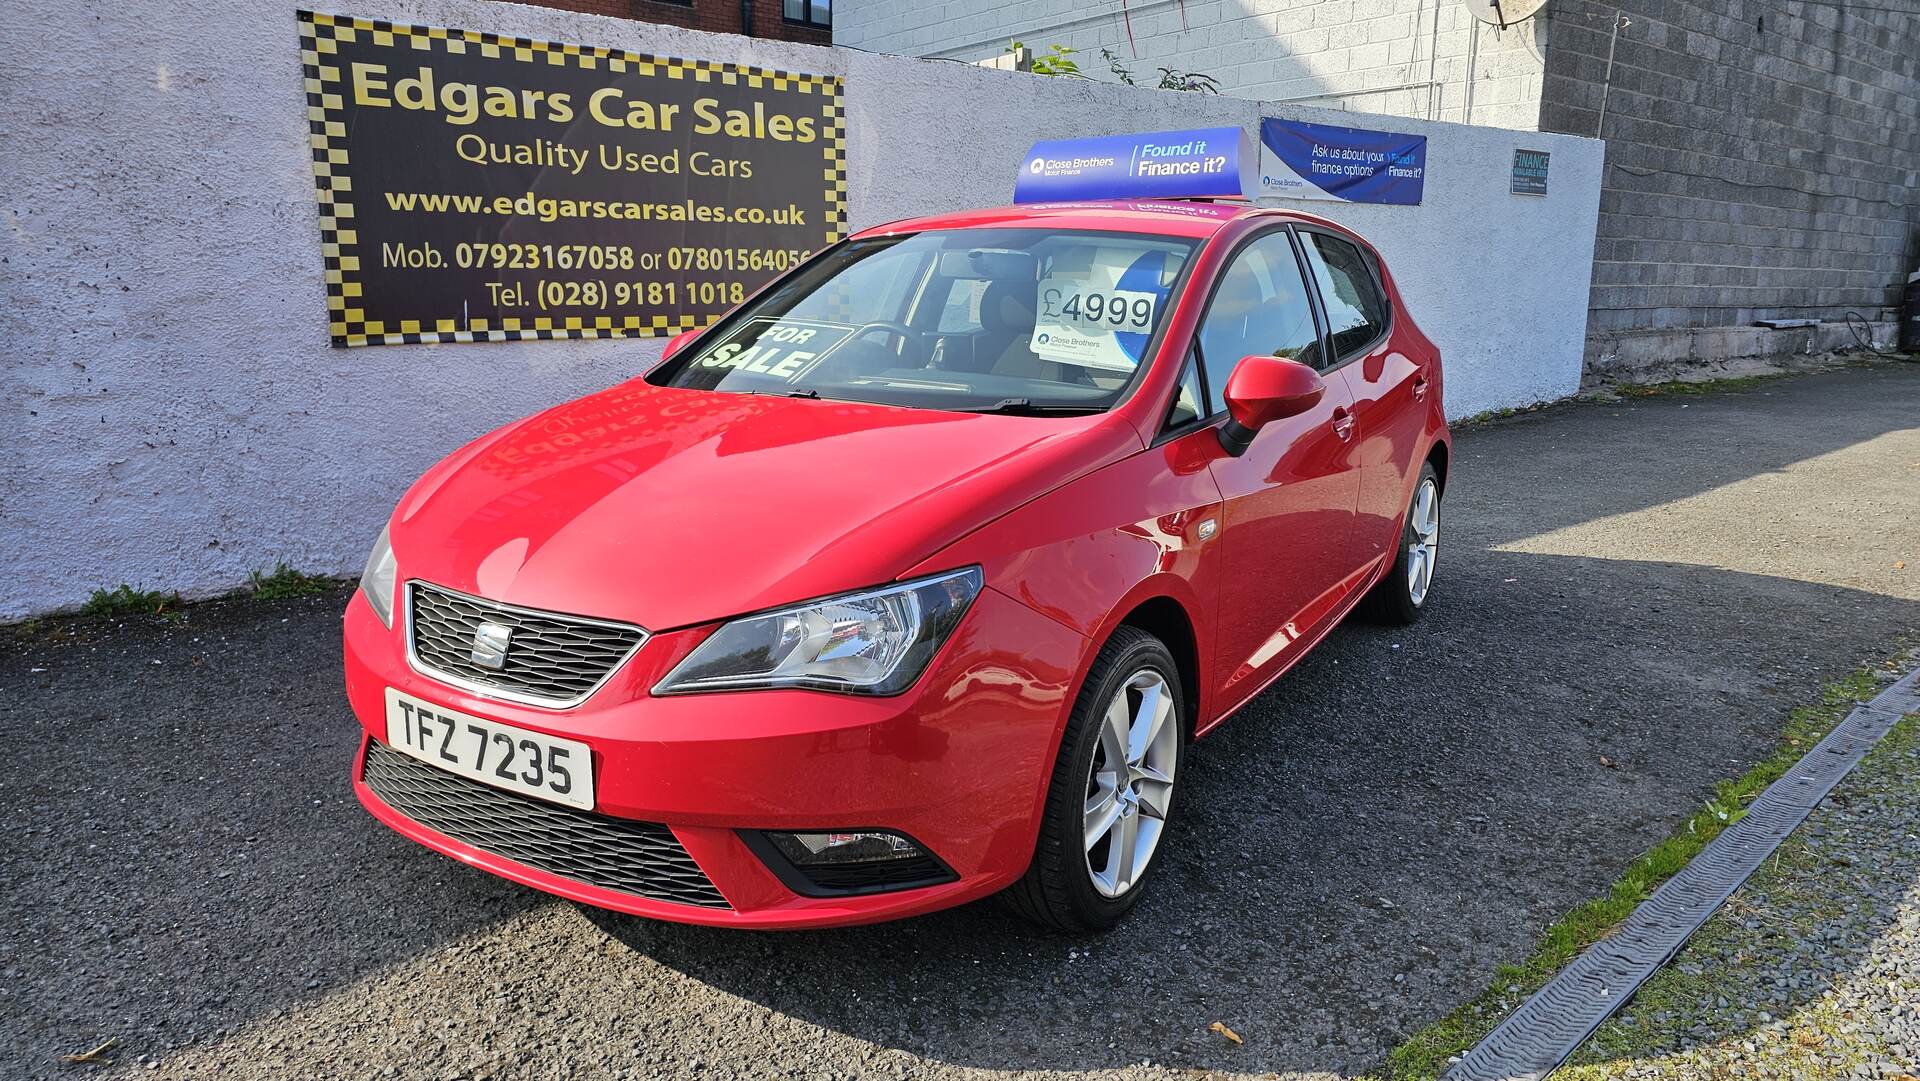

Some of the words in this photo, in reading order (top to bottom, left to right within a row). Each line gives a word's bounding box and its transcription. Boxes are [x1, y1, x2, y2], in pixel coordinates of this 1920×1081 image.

[351, 62, 574, 125] Edgars
[588, 87, 680, 133] Car
[693, 97, 816, 143] Sales
[456, 134, 590, 175] Quality
[599, 144, 680, 174] Used
[689, 151, 753, 179] Cars
[1141, 142, 1193, 158] Found
[1194, 140, 1207, 155] it
[1311, 143, 1329, 158] Ask
[1330, 147, 1341, 159] us
[1341, 146, 1365, 161] about
[1366, 151, 1385, 164] your
[1046, 159, 1072, 170] Close
[1073, 157, 1115, 169] Brothers
[1138, 160, 1200, 177] Finance
[1203, 156, 1226, 174] it?
[1311, 160, 1342, 175] finance
[1343, 163, 1374, 179] options
[1514, 152, 1549, 169] FINANCE
[1388, 165, 1413, 178] Finance
[384, 191, 806, 225] www.edgarscarsales.co.uk
[382, 241, 447, 269] Mob.
[455, 242, 634, 270] 07923167058
[640, 253, 662, 271] or
[486, 281, 529, 307] Tel.
[537, 279, 608, 311] (028)
[614, 281, 676, 306] 9181
[686, 281, 745, 305] 1018
[1042, 288, 1151, 328] £4999
[757, 326, 817, 345] FOR
[1051, 335, 1070, 345] Close
[1071, 337, 1100, 348] Brothers
[702, 343, 816, 378] SALE
[398, 699, 459, 764] TFZ
[467, 724, 572, 795] 7235
